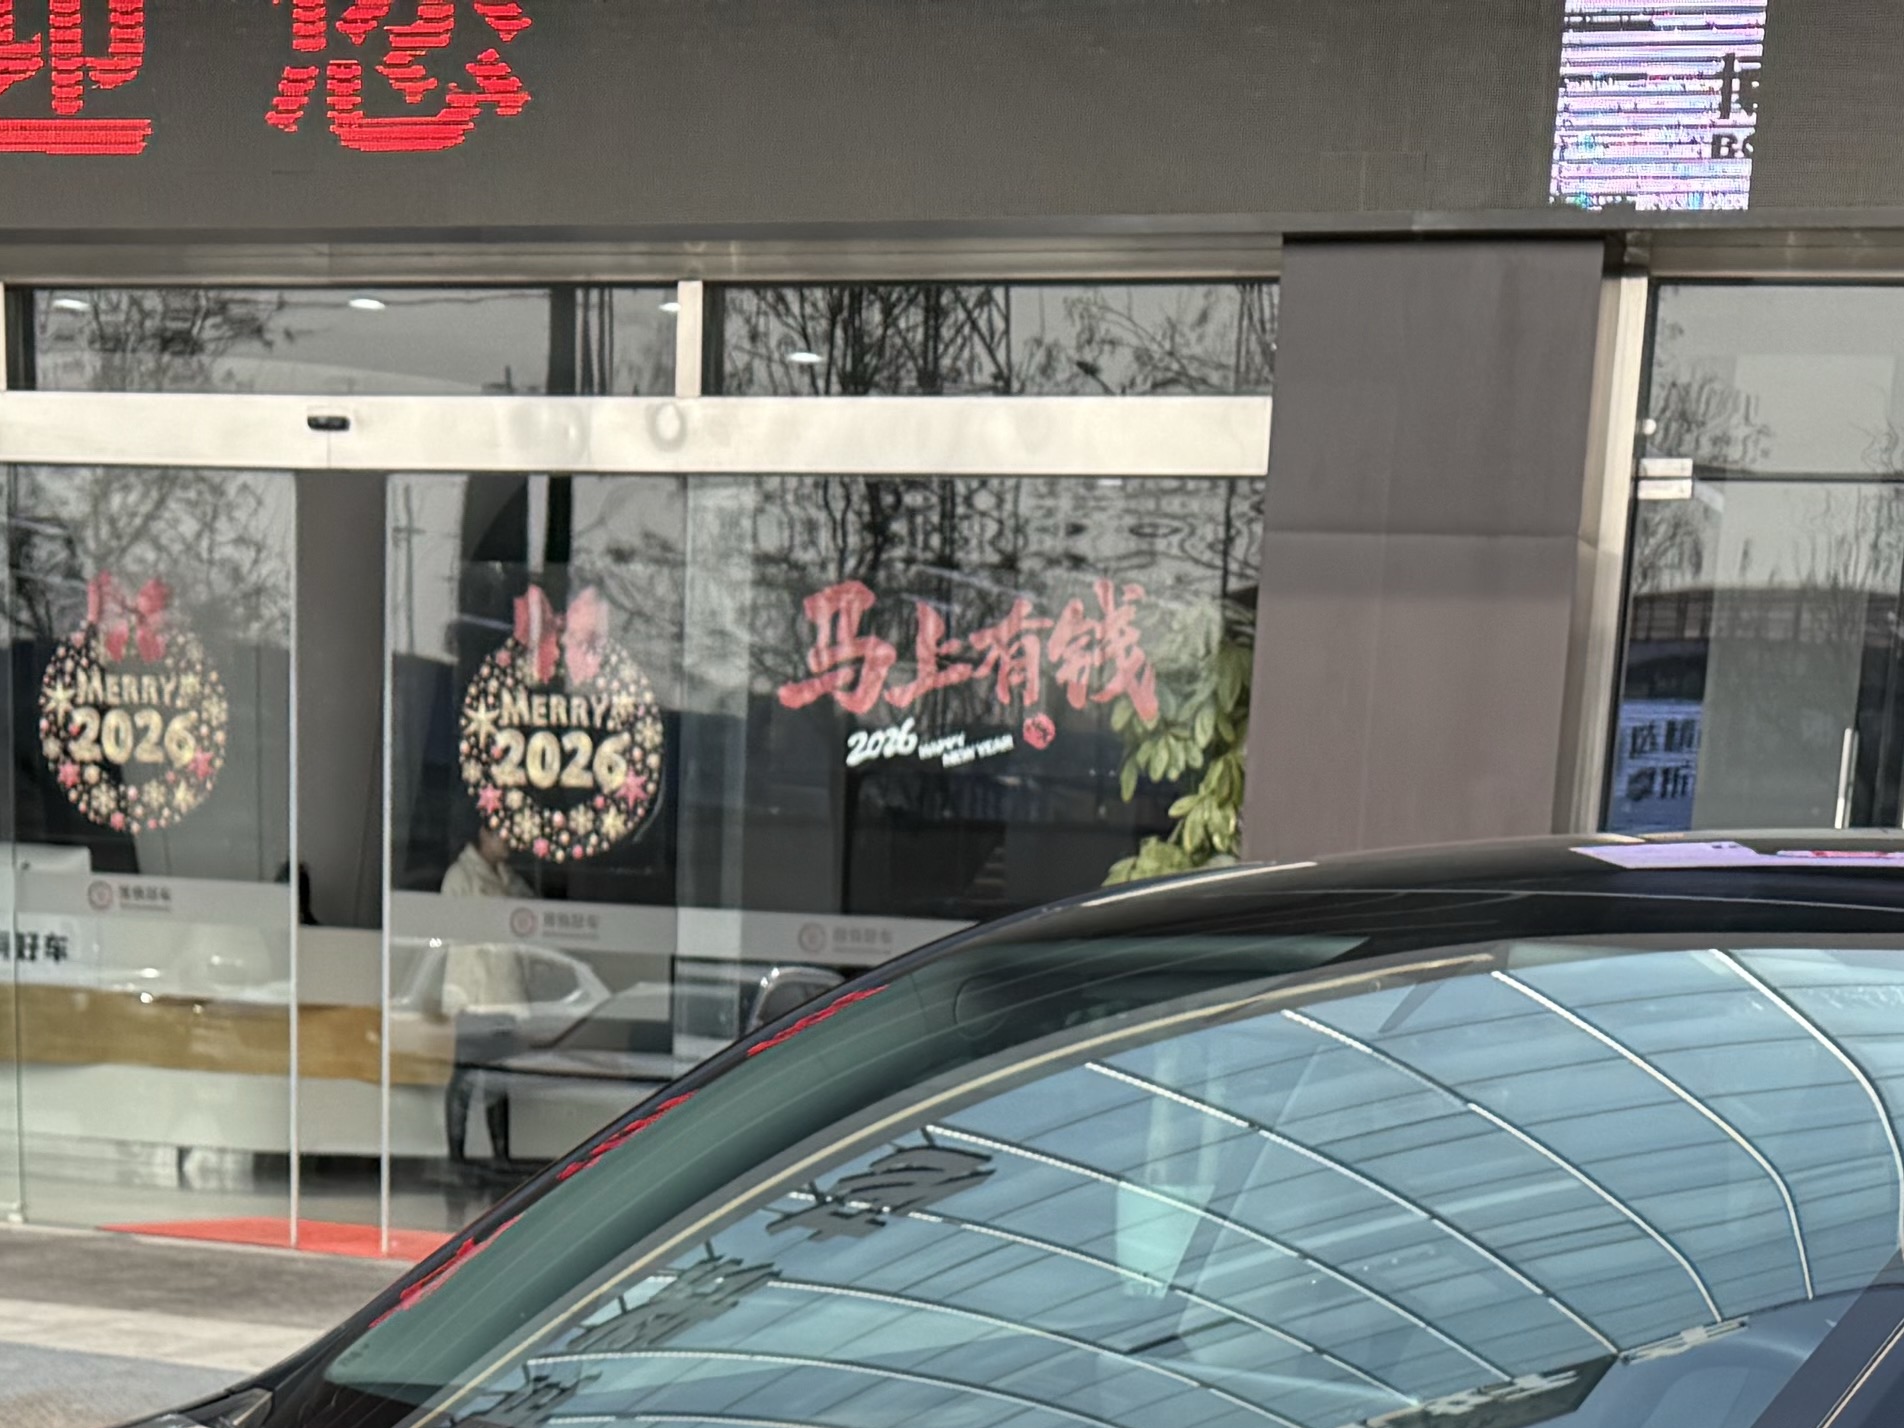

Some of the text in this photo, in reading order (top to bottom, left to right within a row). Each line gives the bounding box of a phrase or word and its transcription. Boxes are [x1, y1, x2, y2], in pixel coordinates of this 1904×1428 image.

[778, 579, 1160, 722] 马上有钱
[74, 664, 177, 706] MERRY
[498, 684, 610, 729] MERRY
[67, 706, 198, 769] 2026
[490, 728, 632, 795] 2026
[845, 717, 919, 768] 2026
